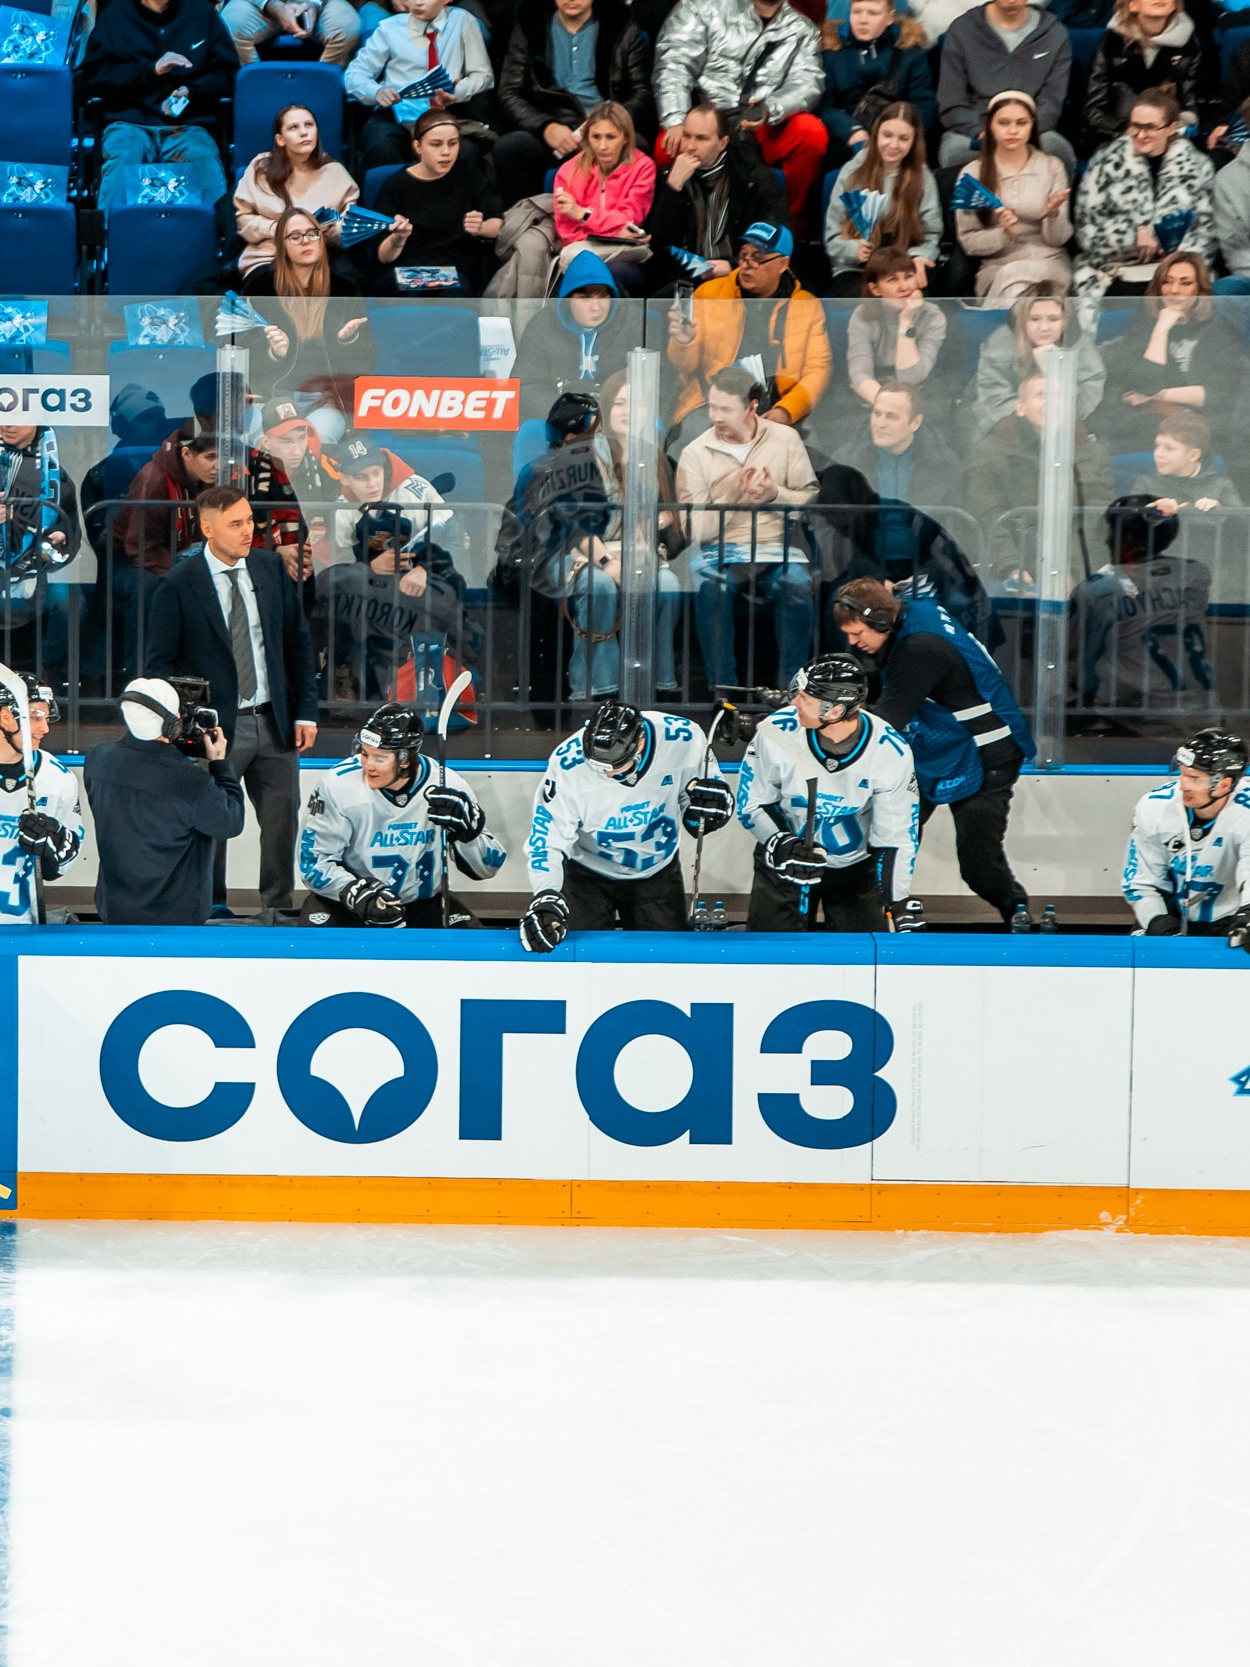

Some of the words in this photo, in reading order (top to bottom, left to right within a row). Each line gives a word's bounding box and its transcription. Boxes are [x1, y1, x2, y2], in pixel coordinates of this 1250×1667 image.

[357, 388, 517, 420] FONBET
[348, 440, 368, 460] 14
[663, 715, 693, 742] 53
[596, 815, 679, 872] 53
[371, 850, 436, 899] 71
[99, 989, 898, 1151] согаз
